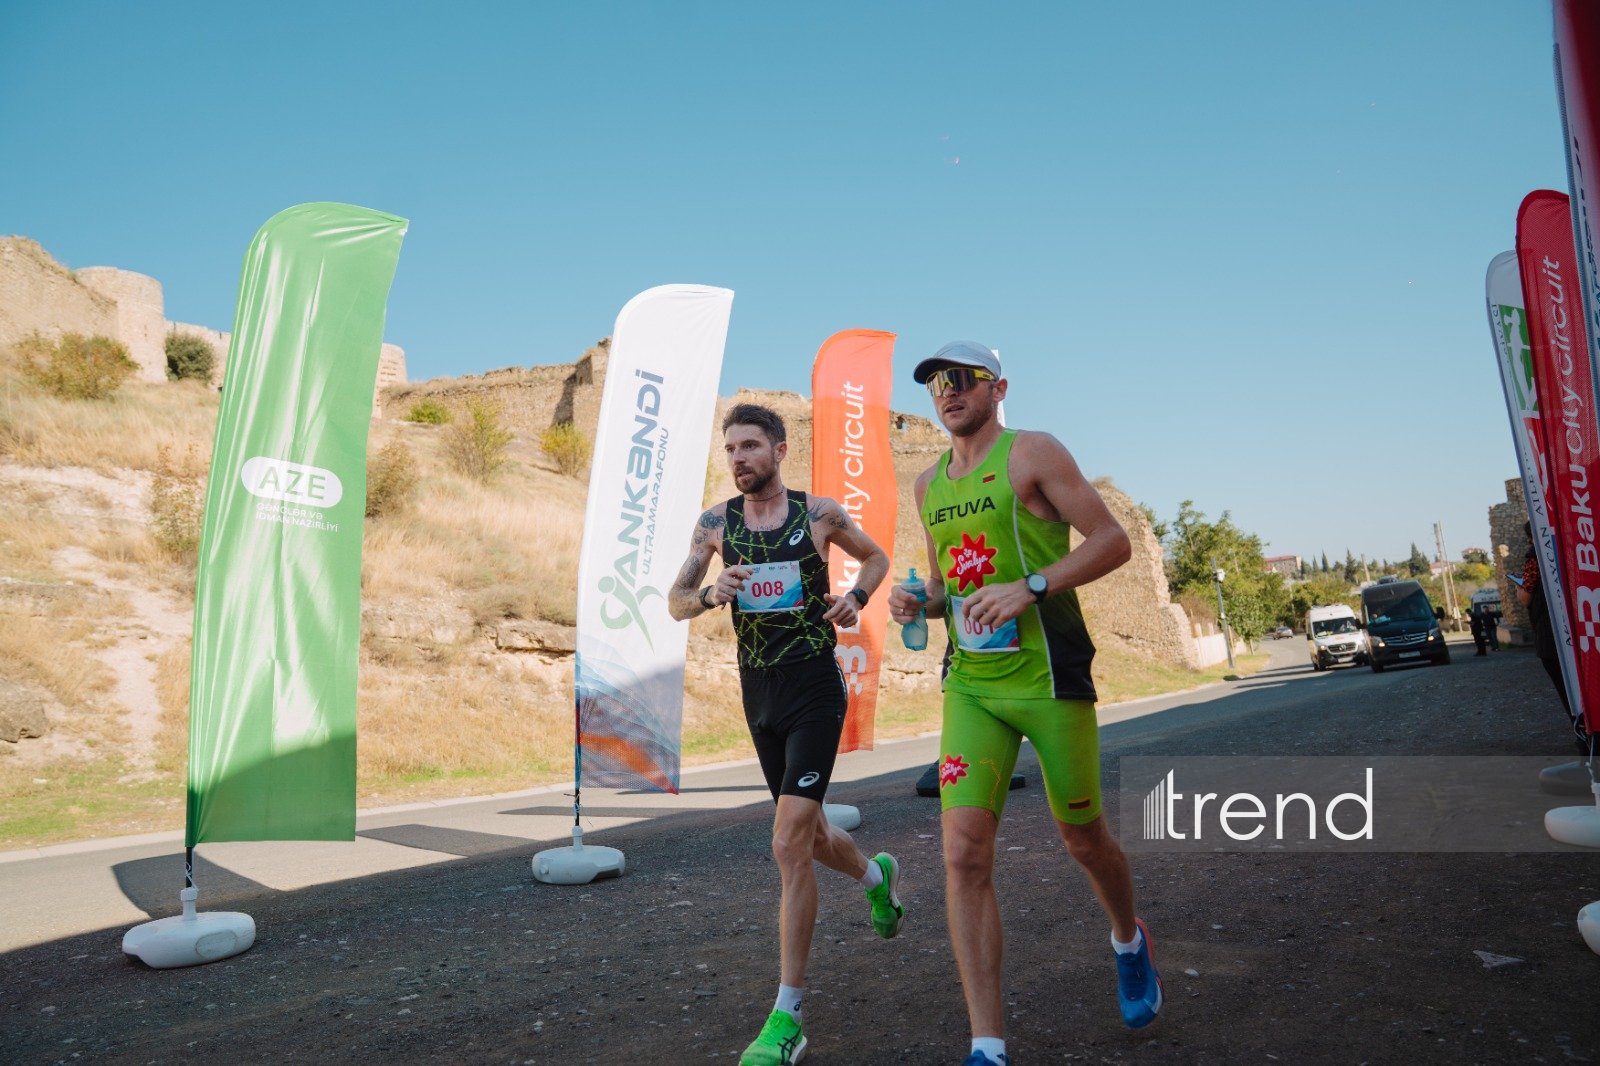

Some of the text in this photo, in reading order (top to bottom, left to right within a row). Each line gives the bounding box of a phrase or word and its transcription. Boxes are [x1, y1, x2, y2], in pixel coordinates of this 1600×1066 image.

[1541, 255, 1573, 377] circuit
[839, 380, 865, 478] circuit
[258, 466, 327, 500] AZE
[641, 427, 670, 575] ULTRAMARAFONU
[928, 496, 996, 527] LIETUVA
[1568, 463, 1600, 573] Baku
[751, 581, 785, 598] 008
